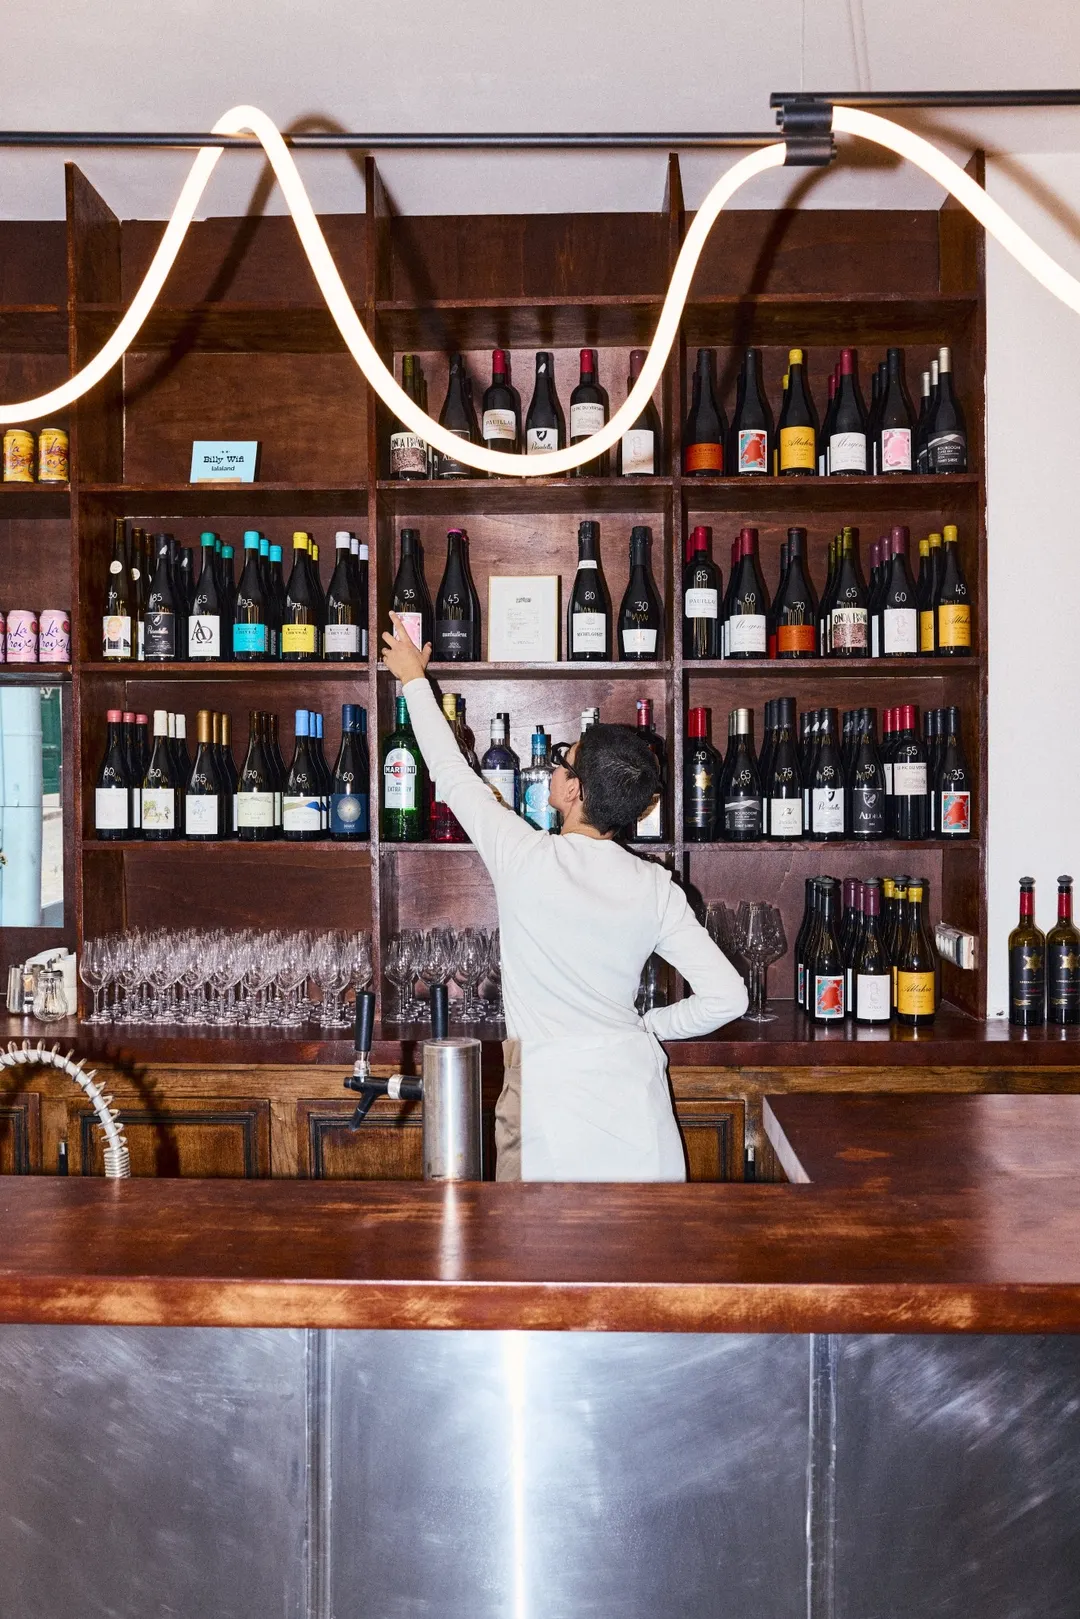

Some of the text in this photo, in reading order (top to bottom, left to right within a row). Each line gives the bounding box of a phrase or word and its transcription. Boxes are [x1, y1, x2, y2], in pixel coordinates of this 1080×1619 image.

[203, 456, 223, 464] Billy
[696, 570, 708, 582] 85
[403, 588, 415, 599] 35
[845, 587, 857, 598] 65
[955, 583, 967, 595] 45
[151, 592, 162, 602] 85
[196, 594, 207, 604] 65
[447, 593, 459, 604] 45
[584, 591, 595, 601] 80
[744, 592, 756, 603] 60
[894, 591, 907, 602] 60
[241, 598, 254, 608] 35
[291, 602, 302, 611] 75
[634, 601, 649, 612] 30
[792, 601, 806, 611] 70
[695, 750, 707, 760] 40
[906, 746, 918, 756] 55
[247, 769, 258, 779] 70
[782, 767, 793, 777] 75
[823, 765, 835, 776] 85
[864, 764, 876, 774] 50
[296, 773, 307, 783] 65
[740, 769, 751, 781] 65
[951, 769, 965, 781] 35
